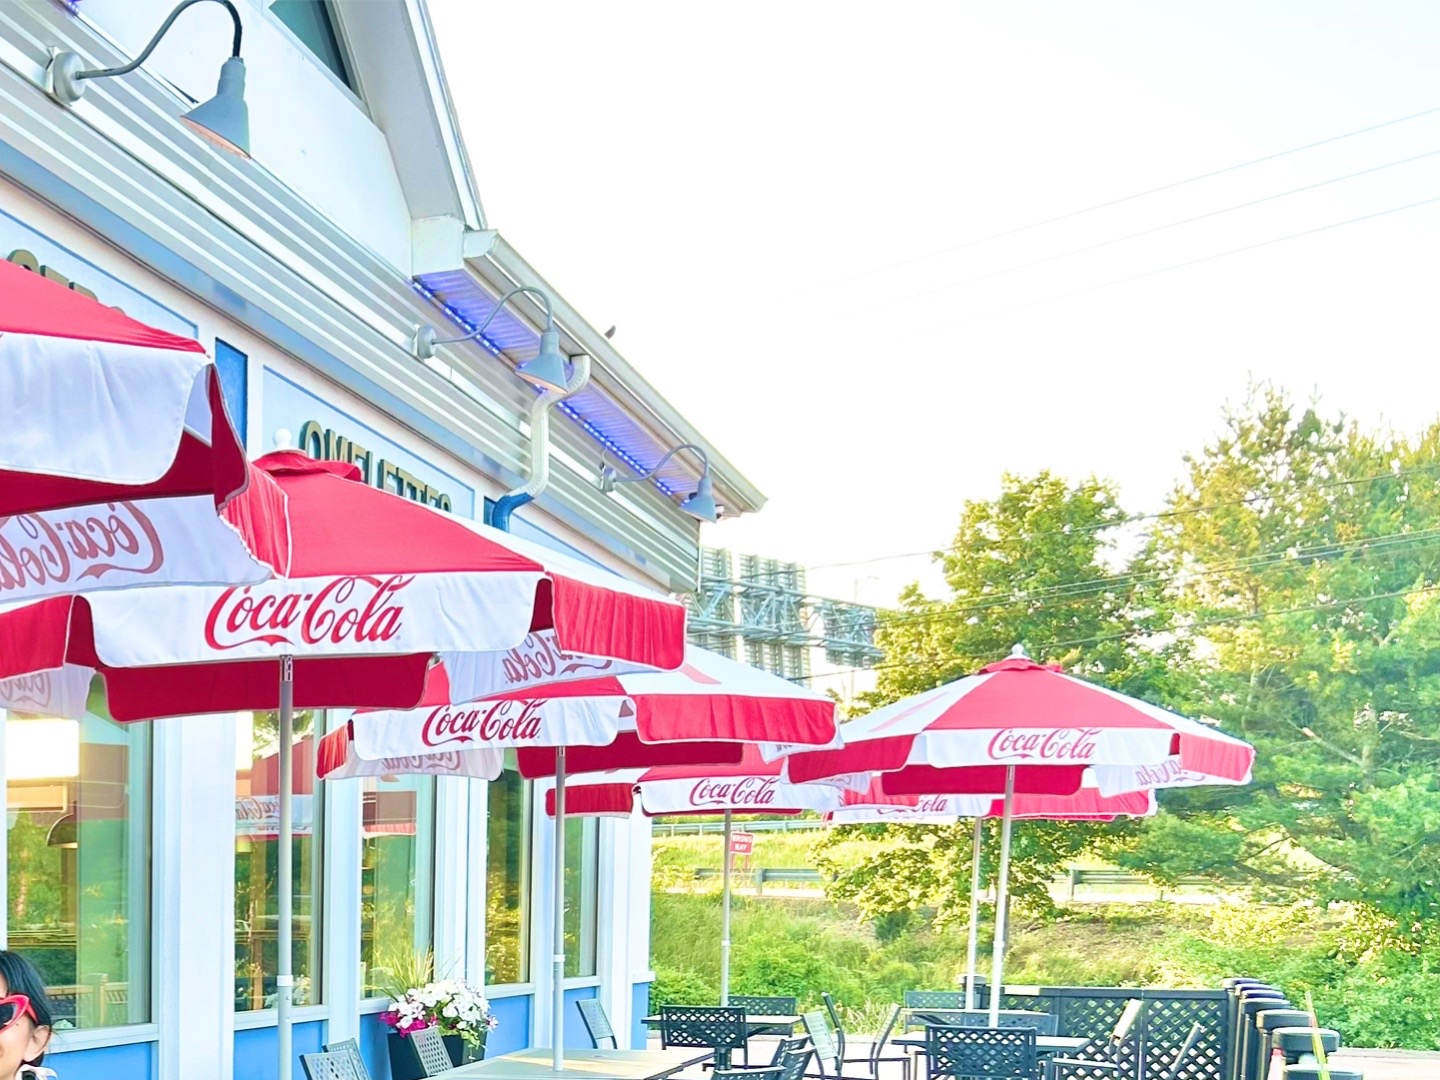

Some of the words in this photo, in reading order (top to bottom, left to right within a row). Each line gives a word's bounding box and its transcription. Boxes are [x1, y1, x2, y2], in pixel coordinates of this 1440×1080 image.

[204, 575, 416, 650] Coca-Cola
[421, 699, 549, 747] Coca-Cola
[987, 728, 1102, 760] Coca-Cola
[689, 776, 780, 806] Coca-Cola
